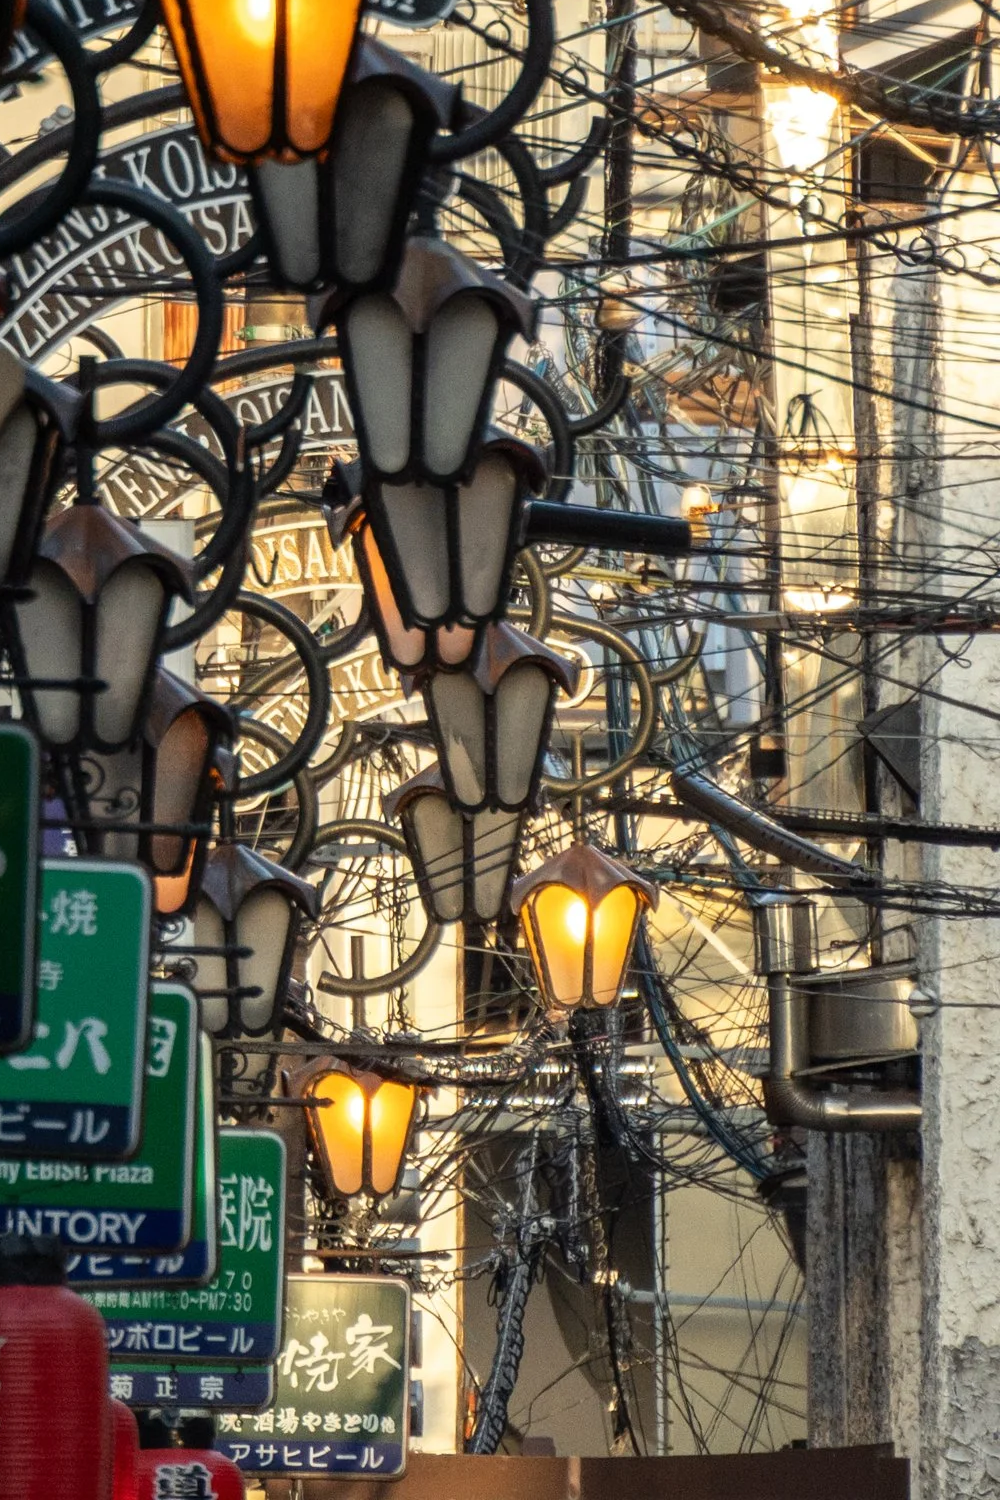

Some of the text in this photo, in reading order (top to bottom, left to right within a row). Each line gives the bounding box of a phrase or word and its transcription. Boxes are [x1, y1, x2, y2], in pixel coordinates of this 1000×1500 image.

[229, 1443, 385, 1469] アサヒビール
